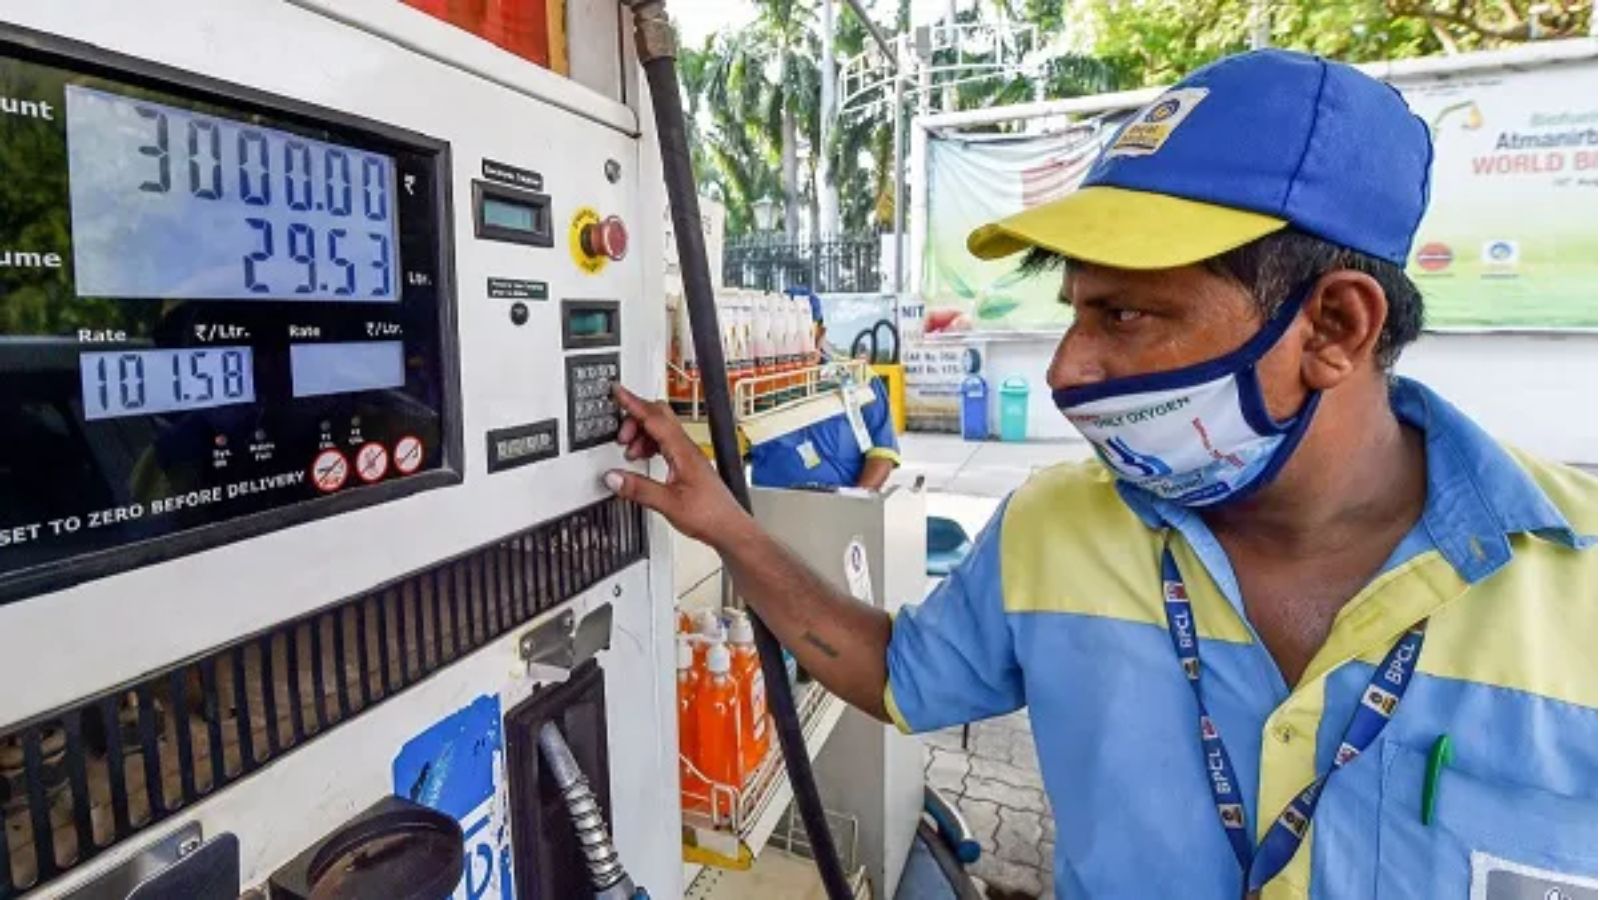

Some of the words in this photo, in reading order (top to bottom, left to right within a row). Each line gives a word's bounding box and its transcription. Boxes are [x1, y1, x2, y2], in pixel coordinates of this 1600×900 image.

[138, 106, 387, 221] 3000.00
[1473, 151, 1564, 175] WORLD
[244, 218, 389, 296] 29.53
[78, 328, 127, 342] Rate
[194, 324, 251, 341] ₹/Ltr.
[289, 324, 320, 337] Rate
[98, 351, 243, 410] 101.58
[1126, 396, 1189, 424] OXYGEN
[47, 515, 81, 536] TO
[87, 503, 143, 529] ZERO
[151, 486, 222, 515] BEFORE
[227, 470, 305, 499] DELIVERY
[1174, 612, 1193, 648] BPCL
[1384, 643, 1415, 685] BPCL
[1209, 748, 1231, 794] BPCL
